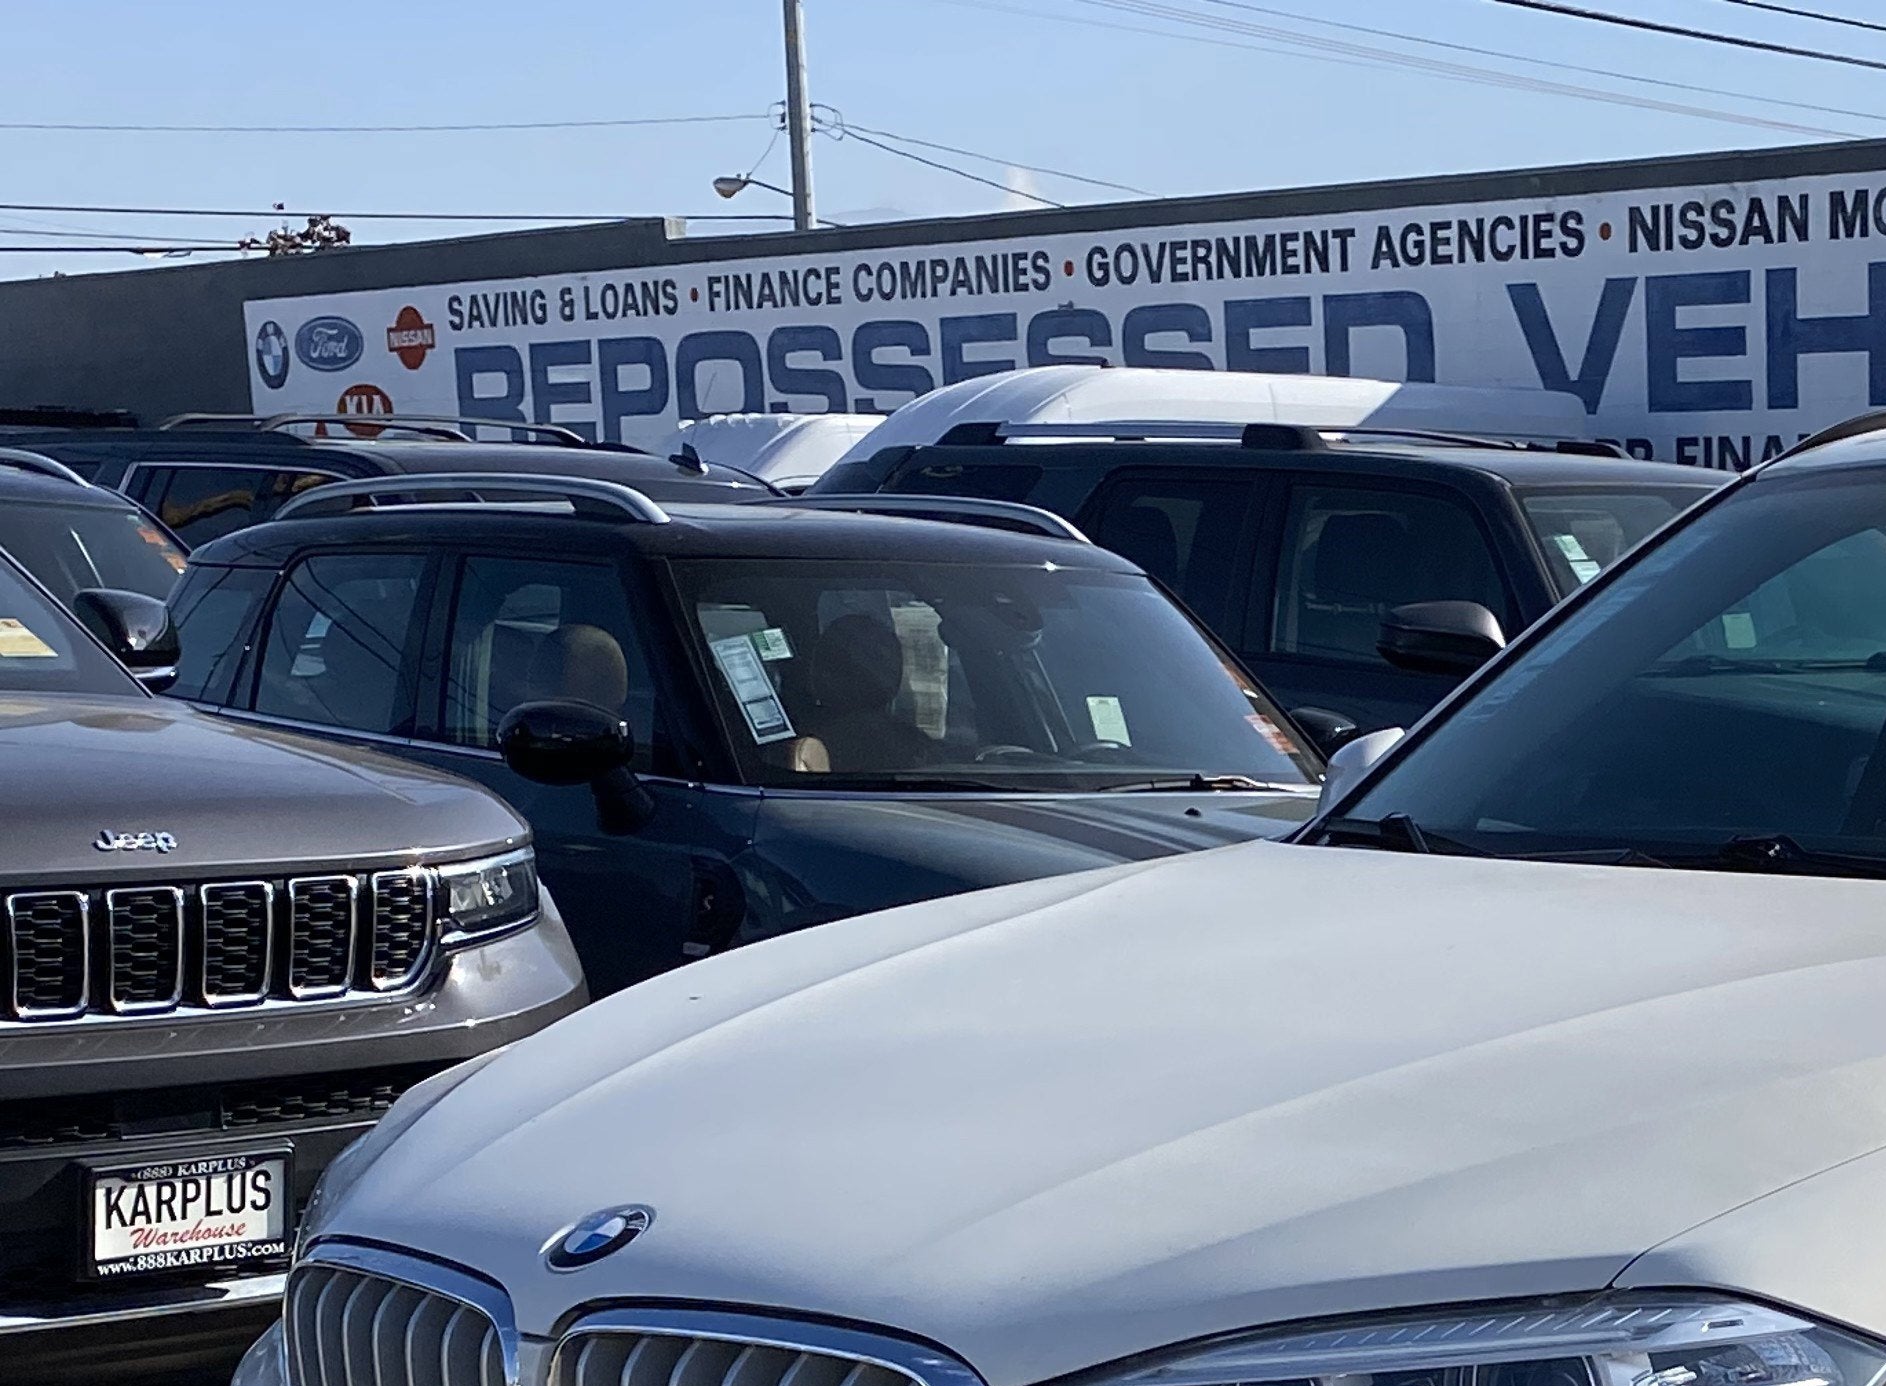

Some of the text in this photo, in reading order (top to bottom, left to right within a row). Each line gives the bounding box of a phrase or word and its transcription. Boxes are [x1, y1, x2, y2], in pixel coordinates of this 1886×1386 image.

[1085, 209, 1586, 288] GOVERNMENT AGENCIES
[1628, 194, 1809, 253] NISSAN
[448, 278, 680, 332] SAVING & LOANS
[707, 250, 1052, 312] FINANCE COMPANIES
[310, 327, 349, 359] Ford
[95, 829, 178, 853] Jeep
[177, 1156, 247, 1177] KARPLUS
[104, 1168, 273, 1230] KARPLUS
[129, 1219, 247, 1250] Warehouse
